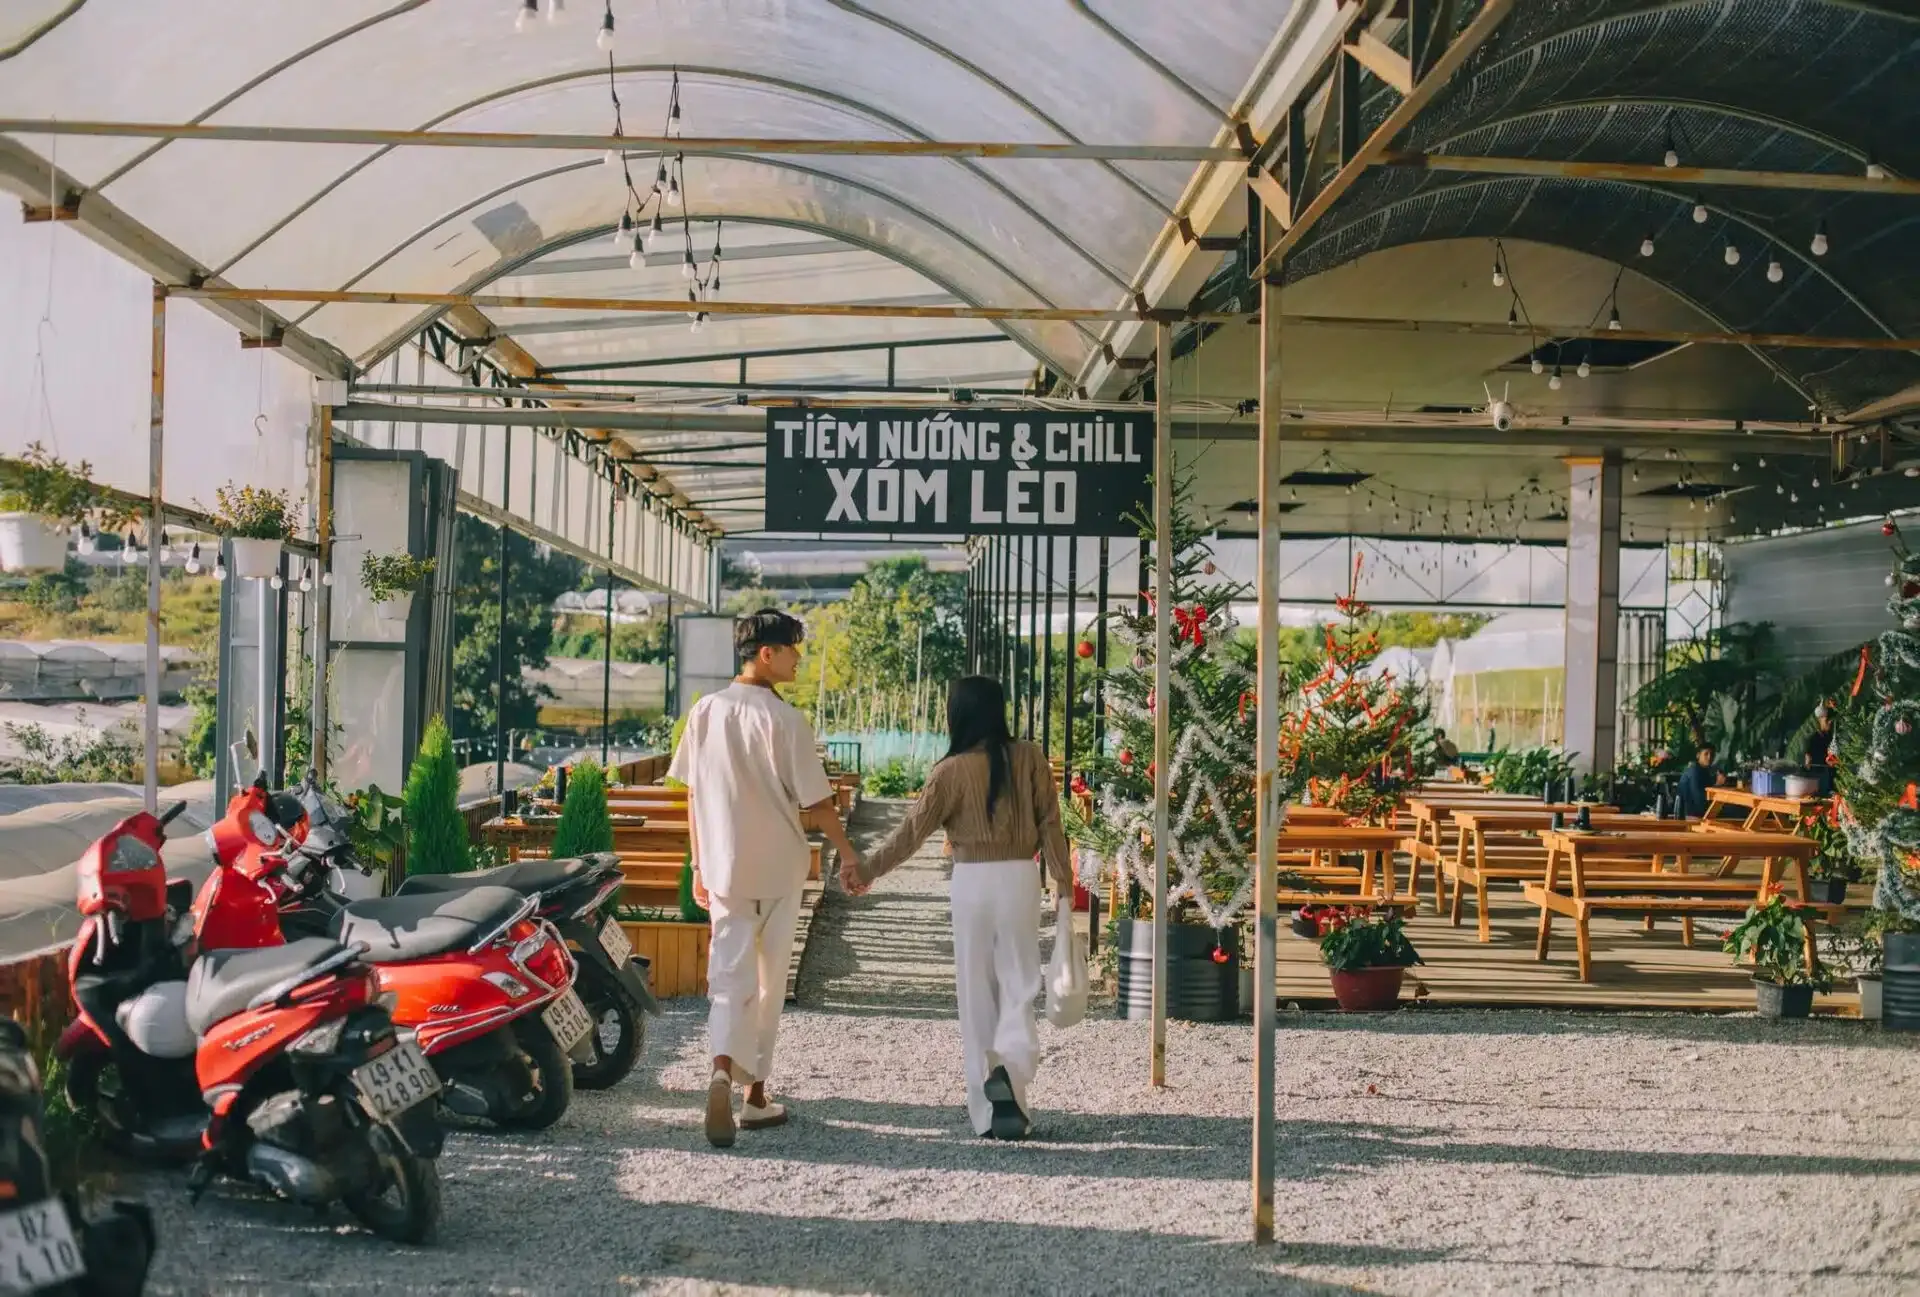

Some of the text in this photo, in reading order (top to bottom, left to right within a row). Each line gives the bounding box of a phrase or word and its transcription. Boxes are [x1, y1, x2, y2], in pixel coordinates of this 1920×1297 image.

[878, 412, 1000, 461] NƯỚNG
[1011, 422, 1039, 461] &
[825, 460, 1077, 524] XÓM LÈO
[557, 1010, 590, 1047] 16304
[374, 1068, 434, 1115] 24890
